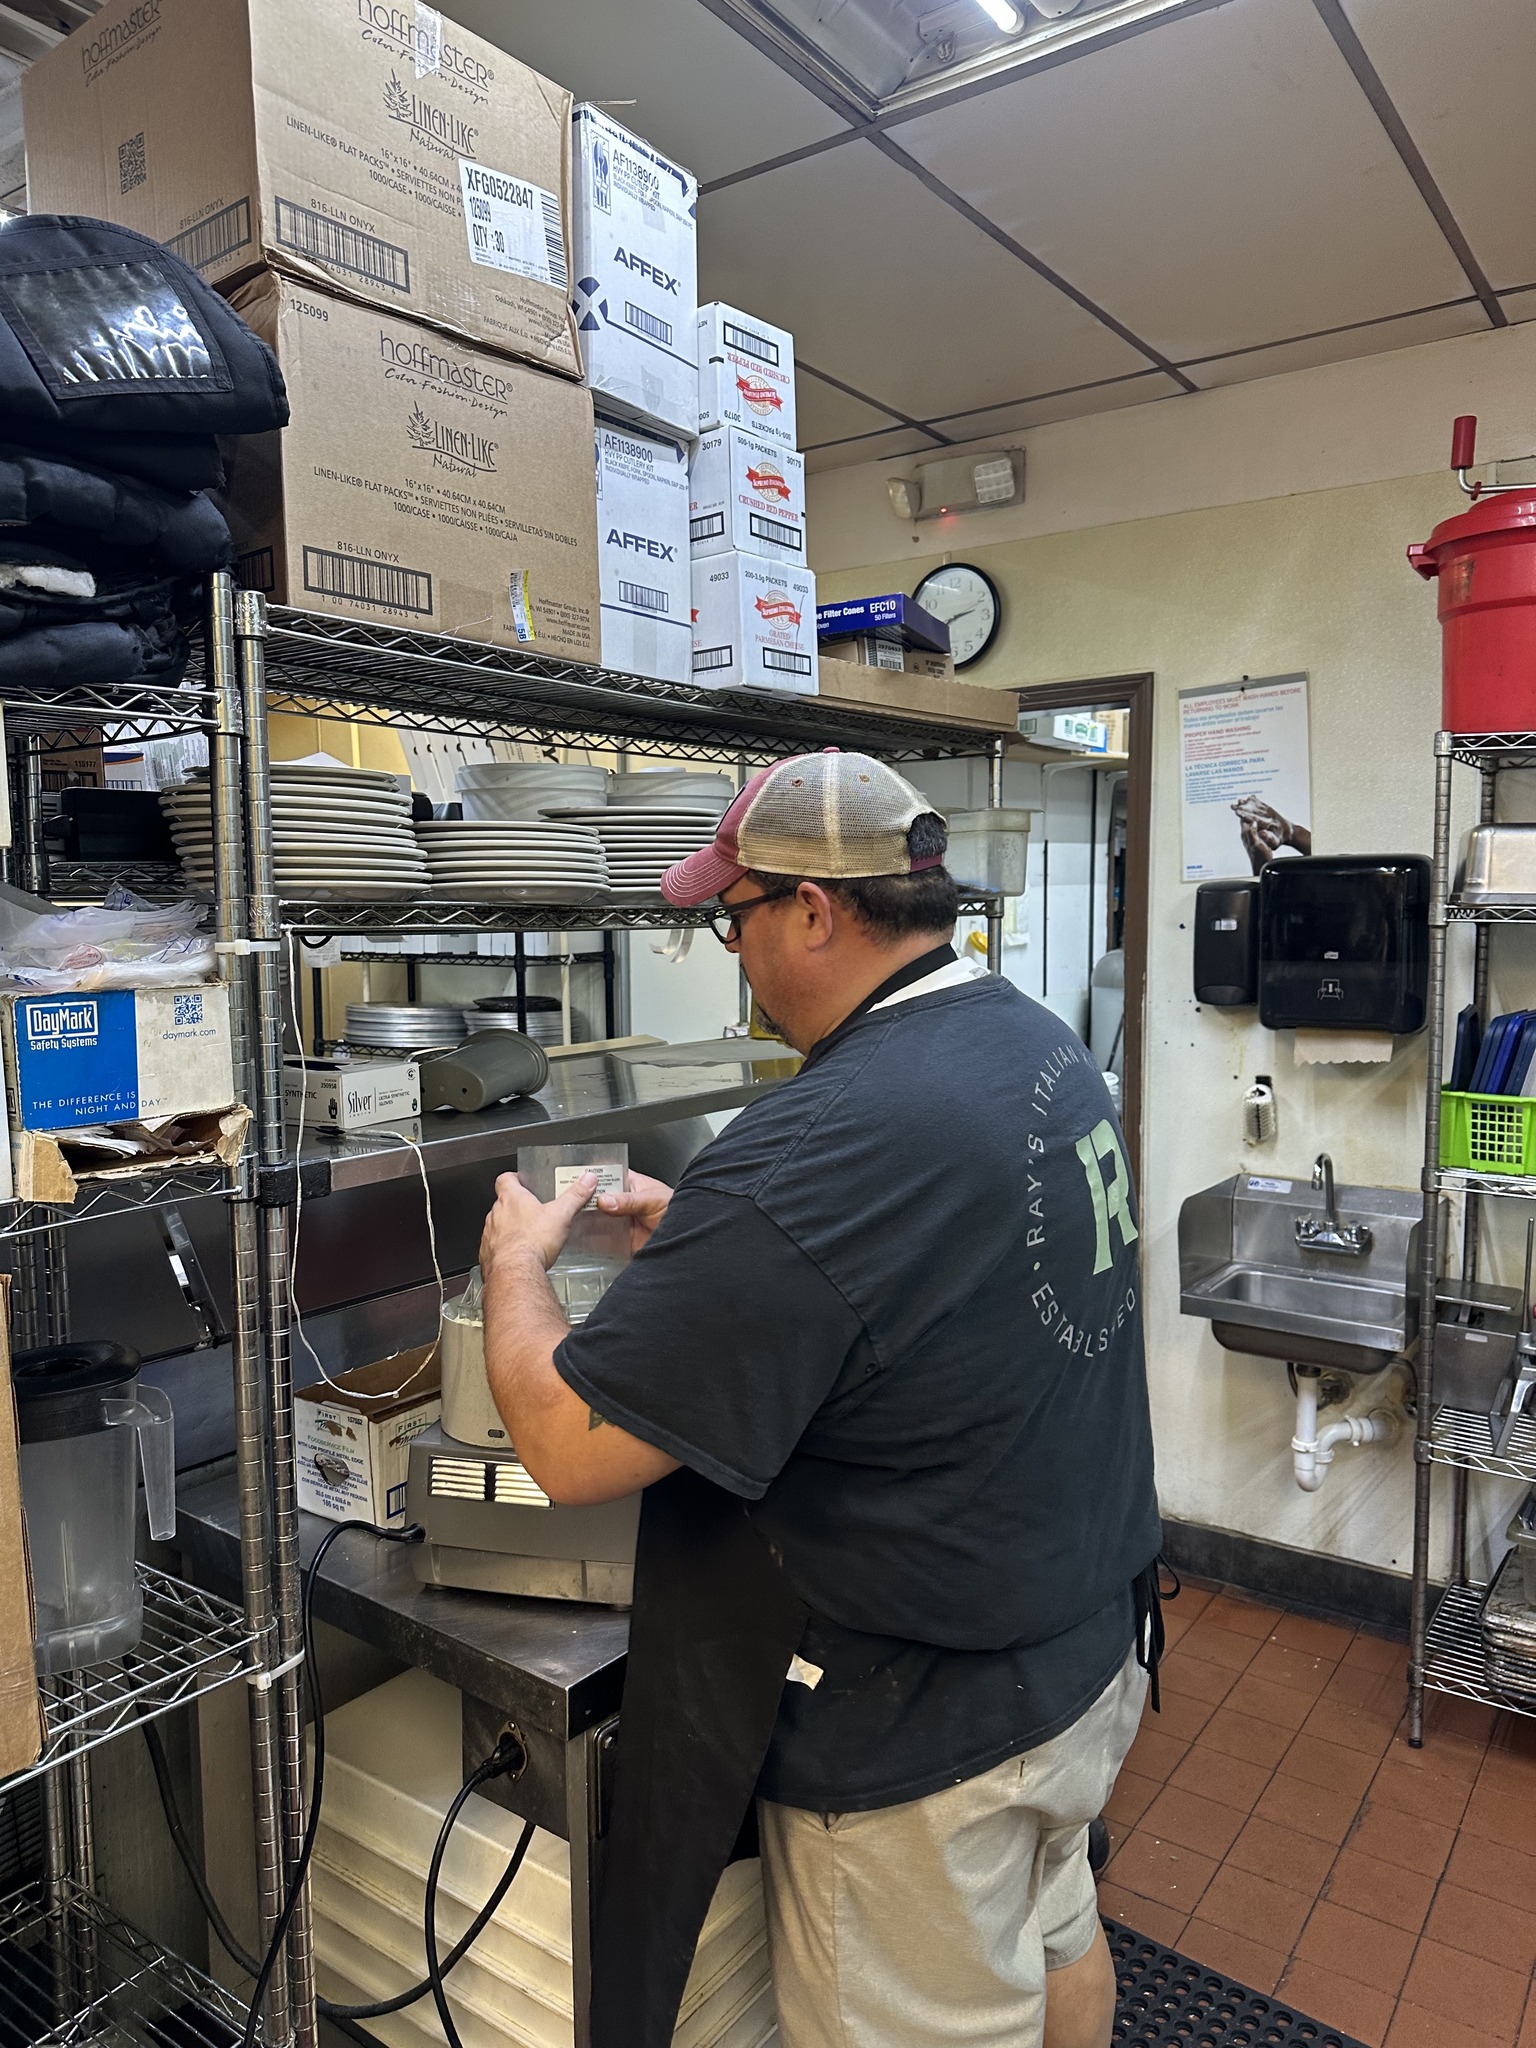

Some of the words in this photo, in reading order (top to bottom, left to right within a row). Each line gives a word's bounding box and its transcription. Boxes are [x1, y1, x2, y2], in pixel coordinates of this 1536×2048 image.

[339, 141, 357, 156] FLAT
[397, 168, 438, 195] SERVIETTES
[438, 188, 455, 203] NON
[419, 167, 449, 187] 40.64CM
[369, 170, 407, 194] 1000/CASE
[414, 190, 456, 217] 1000/CAISSE
[465, 167, 534, 210] XFG0522847
[205, 197, 224, 213] ONYX
[311, 199, 347, 222] 816-LLN
[349, 215, 376, 233] ONYX
[473, 223, 488, 248] QTY
[359, 275, 386, 291] 28943
[290, 298, 329, 322] 125099
[751, 420, 775, 434] PACKETS
[604, 433, 653, 463] AF1138900
[702, 438, 722, 451] 30179
[755, 442, 778, 458] PACKETS
[432, 453, 477, 478] Natural
[624, 456, 646, 469] CUTLERY
[646, 463, 655, 472] KIT
[786, 456, 802, 468] 30179
[442, 489, 471, 505] 40.64CM
[478, 500, 506, 514] 40.64CM
[738, 494, 765, 511] CRUSHED
[766, 503, 778, 515] RED
[778, 508, 799, 522] PEPPER
[364, 480, 382, 492] FLAT
[420, 495, 459, 514] SERVIETTES
[461, 506, 477, 518] NON
[478, 508, 499, 525] PLIÉES
[505, 519, 543, 537] SERVILLETAS
[544, 529, 554, 540] SIN
[555, 533, 578, 547] DOBLES
[393, 501, 430, 519] 1000/CASE
[438, 513, 478, 531] 1000/CAISSE
[485, 525, 518, 542] 1000/CAJA
[337, 541, 372, 556] 816-LLN
[374, 549, 400, 563] ONYX
[709, 571, 730, 582] 49033
[765, 575, 788, 588] PACKETS
[949, 577, 961, 588] 12
[977, 590, 985, 602] 2
[350, 600, 376, 611] 74031
[382, 605, 409, 618] 28943
[823, 608, 842, 619] Filter
[843, 605, 865, 616] Cones
[870, 600, 896, 614] EFC10
[925, 599, 938, 610] 10
[981, 609, 990, 620] 3
[581, 632, 591, 640] USA
[975, 627, 984, 638] 4
[755, 634, 784, 647] PARMESAN
[784, 640, 805, 650] CHEESE
[964, 640, 973, 651] 5
[1193, 698, 1226, 708] EMPLOYEES
[1243, 693, 1259, 701] WASH
[1259, 690, 1279, 698] HANDS
[1279, 687, 1302, 696] BEFORE
[1183, 706, 1214, 715] RETURNING
[1223, 702, 1239, 710] WORK
[1184, 731, 1207, 739] PROPER
[1207, 728, 1225, 736] HAND
[1225, 725, 1251, 734] WASHING
[1218, 758, 1248, 768] CORRECTA
[1249, 757, 1265, 765] PARA
[1185, 769, 1210, 778] LAVARSE
[1210, 767, 1223, 775] LAS
[162, 1028, 217, 1041] daymark.com
[30, 1039, 59, 1051] Safety
[61, 1036, 98, 1049] Systems
[1032, 1044, 1080, 1117] ITALIAN
[32, 1100, 53, 1110] THE
[58, 1092, 122, 1108] DIFFERENCE
[126, 1090, 136, 1100] IS
[347, 1090, 372, 1114] Silver
[378, 1099, 394, 1107] GLOVES
[75, 1104, 108, 1115] NIGHT
[113, 1101, 136, 1112] AND
[317, 1410, 337, 1421] FIRST
[397, 1418, 423, 1433] FIRST
[342, 1443, 355, 1454] FILM
